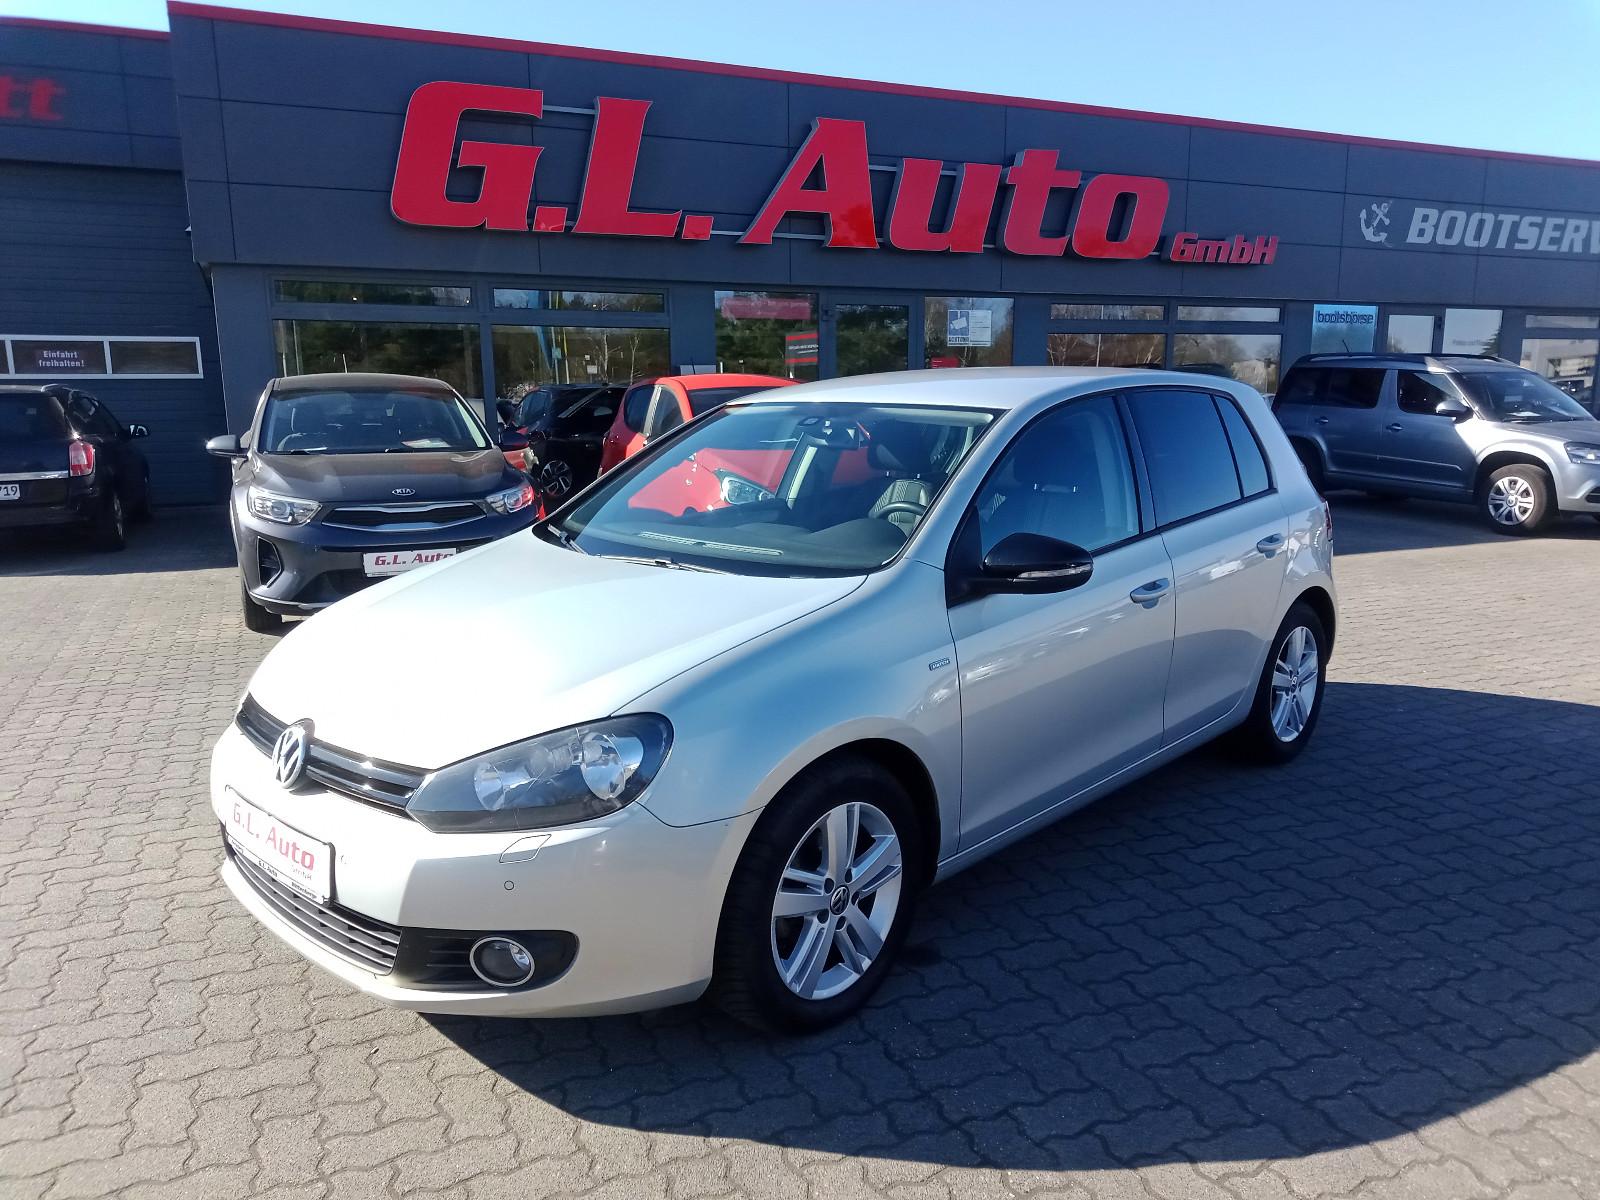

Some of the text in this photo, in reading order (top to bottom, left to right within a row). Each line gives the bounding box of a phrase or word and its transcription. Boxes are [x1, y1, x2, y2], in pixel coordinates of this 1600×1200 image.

[390, 81, 1279, 265] G.L. Auto GmbH
[43, 350, 78, 359] Einfahrt
[38, 359, 85, 368] freihalten!
[0, 485, 18, 497] 19
[374, 555, 407, 567] G.L.
[233, 802, 315, 871] G.L. Auto
